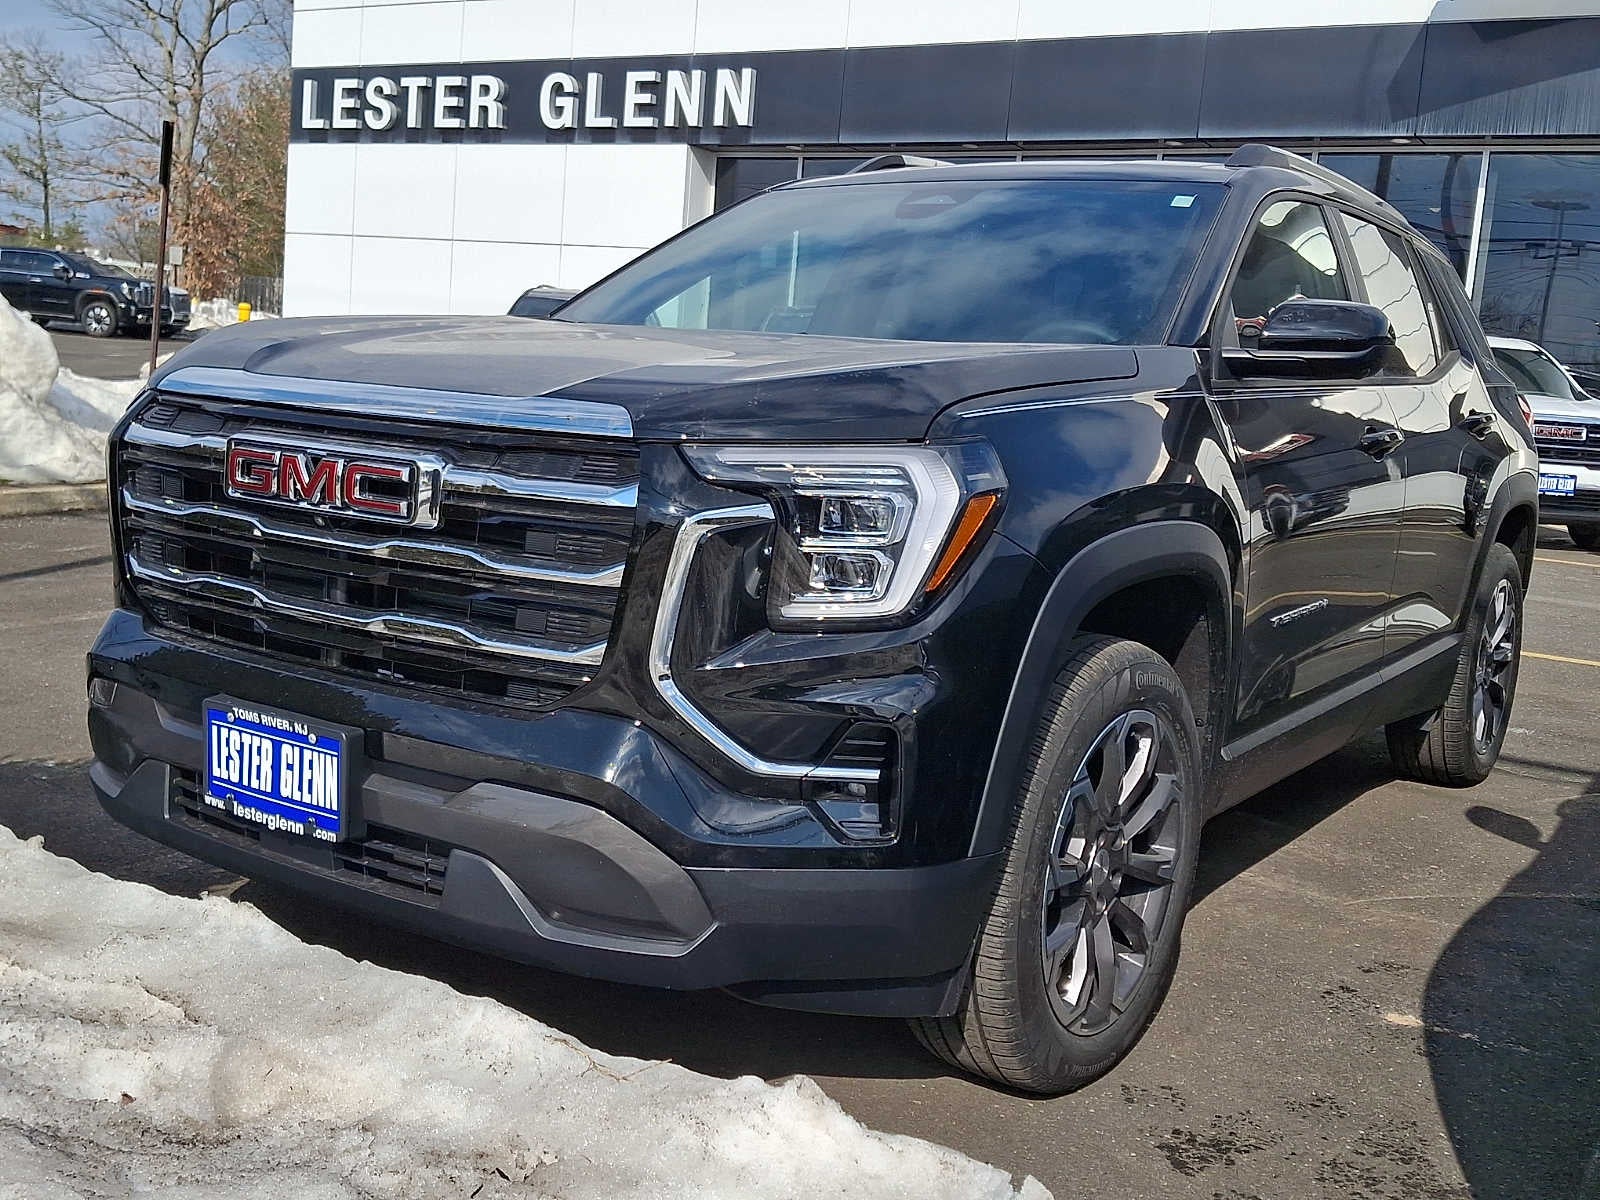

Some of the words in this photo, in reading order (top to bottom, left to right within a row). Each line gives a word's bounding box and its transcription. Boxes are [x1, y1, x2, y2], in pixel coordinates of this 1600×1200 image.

[301, 75, 506, 130] LESTER
[539, 68, 756, 130] GLENN
[1536, 427, 1584, 439] GMC
[228, 447, 408, 515] GMC
[232, 707, 260, 724] TOMS
[294, 722, 309, 736] NJ
[211, 724, 273, 793] LESTER
[279, 742, 338, 811] GLENN
